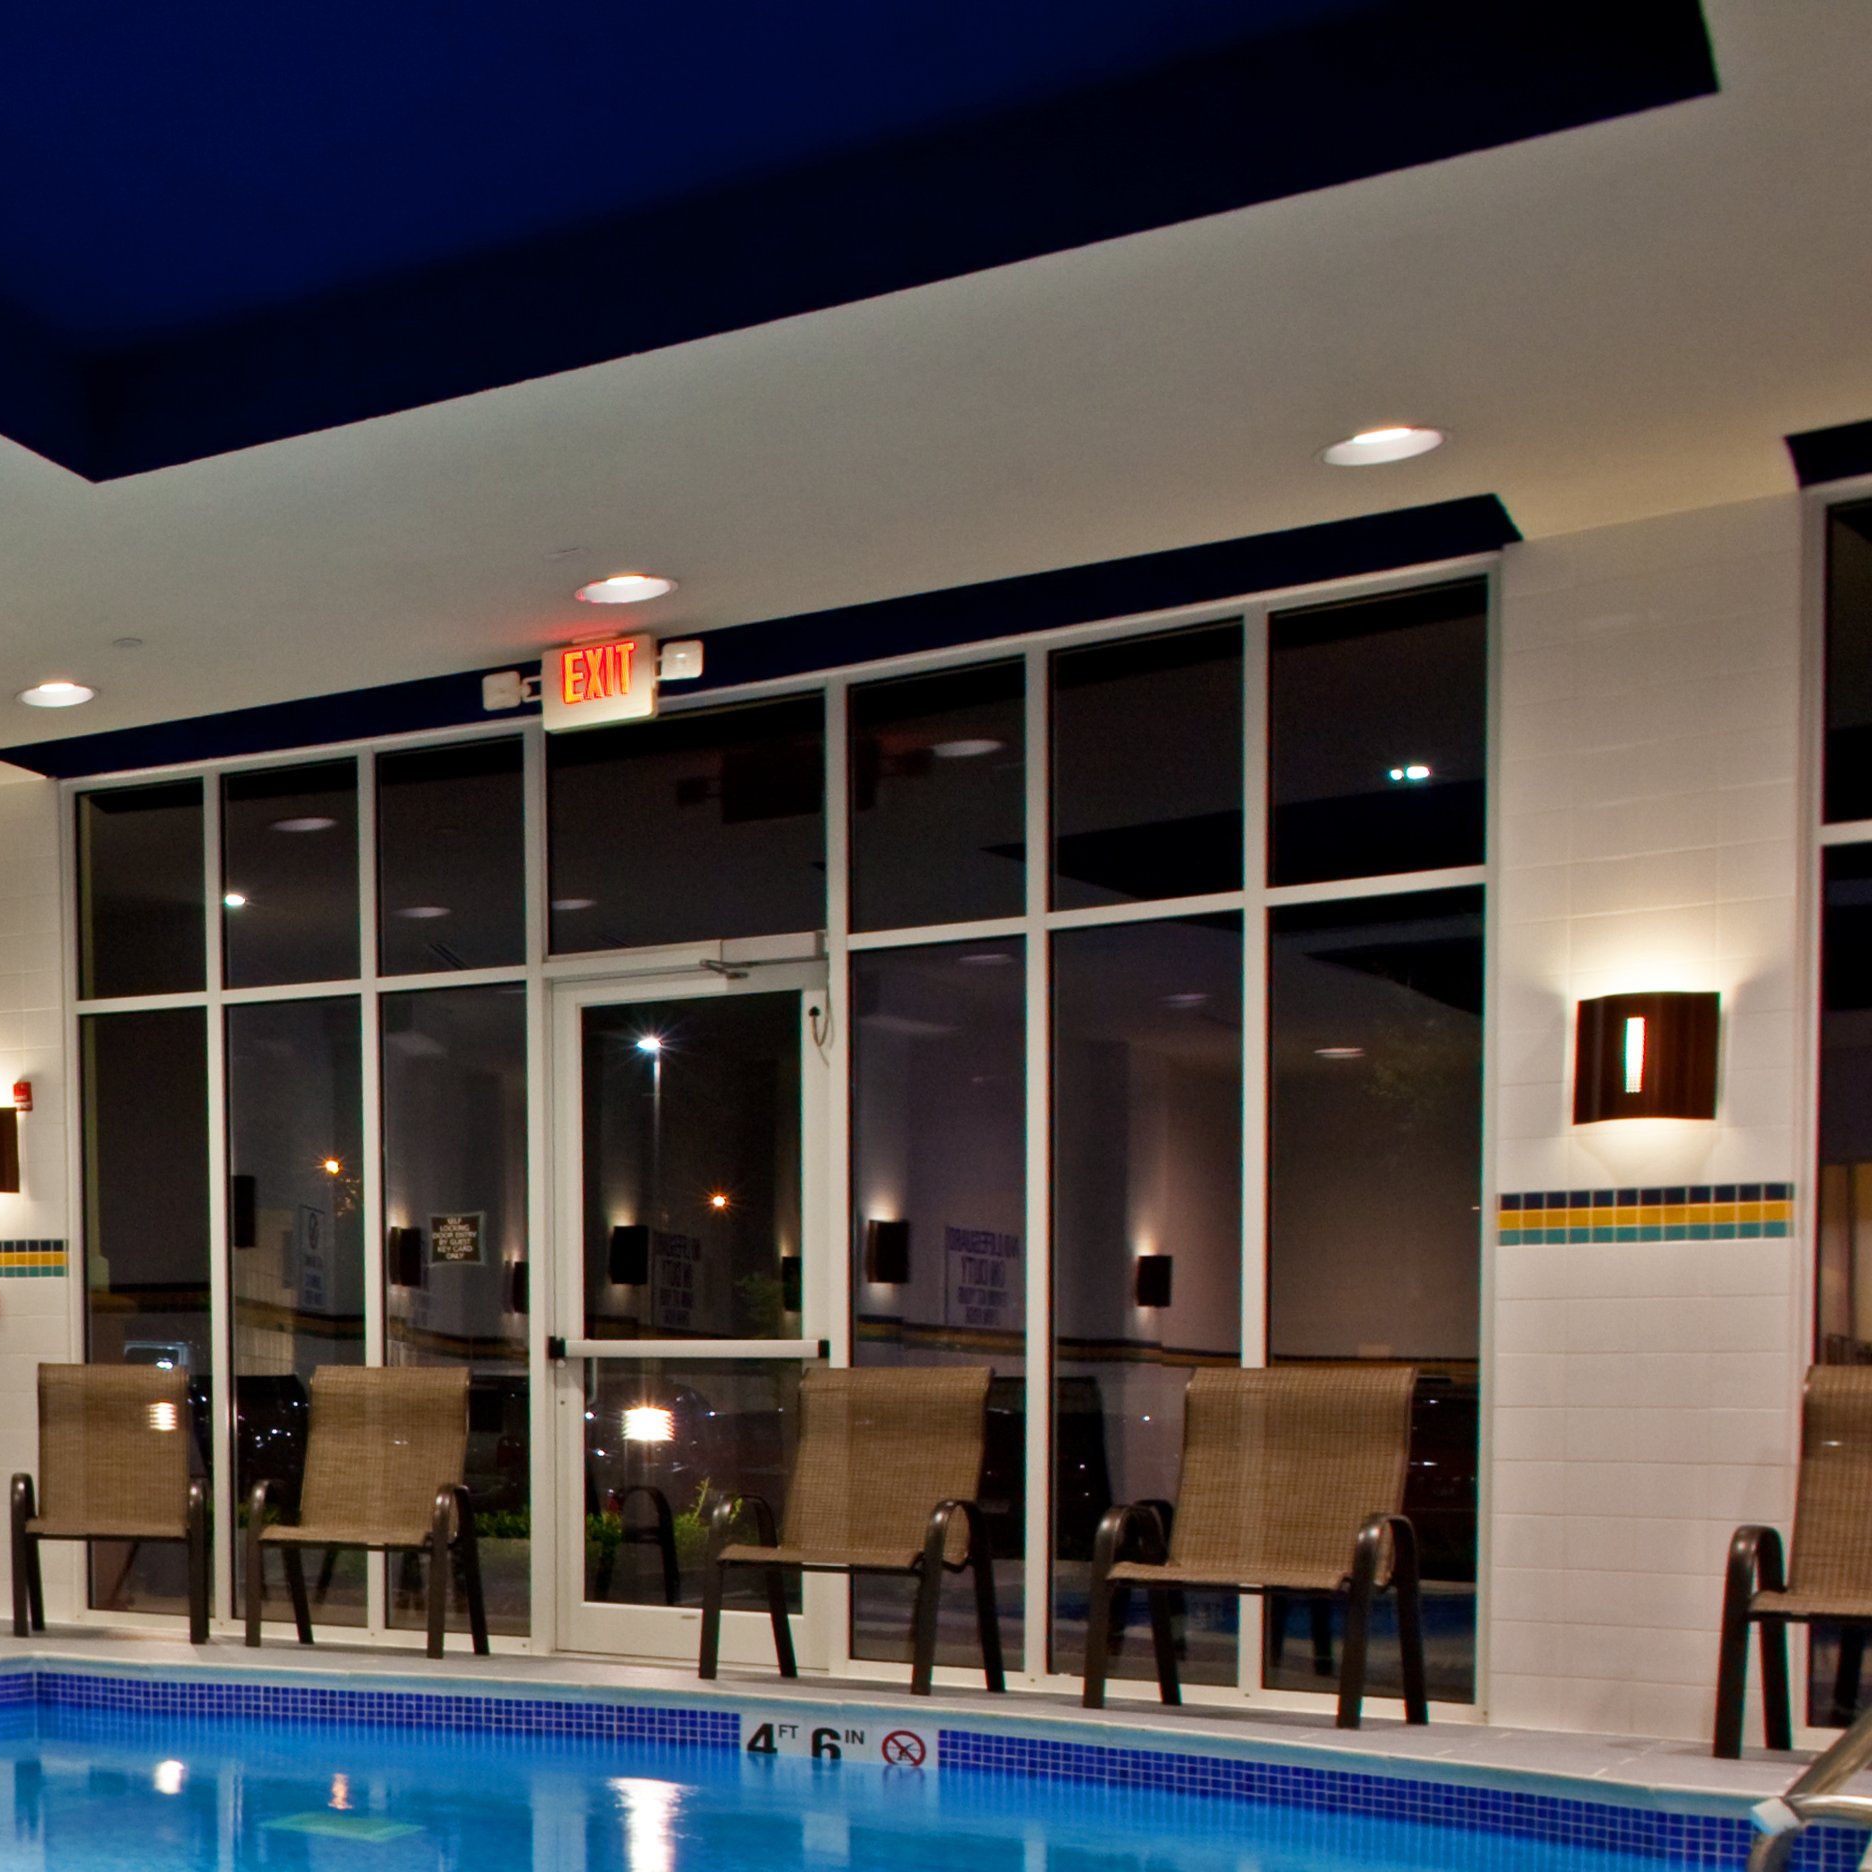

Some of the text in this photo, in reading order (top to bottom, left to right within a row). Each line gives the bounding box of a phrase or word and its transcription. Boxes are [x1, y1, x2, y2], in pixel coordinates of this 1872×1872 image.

[562, 641, 636, 705] EXIT
[747, 1723, 864, 1760] 4 FT 6 IN
